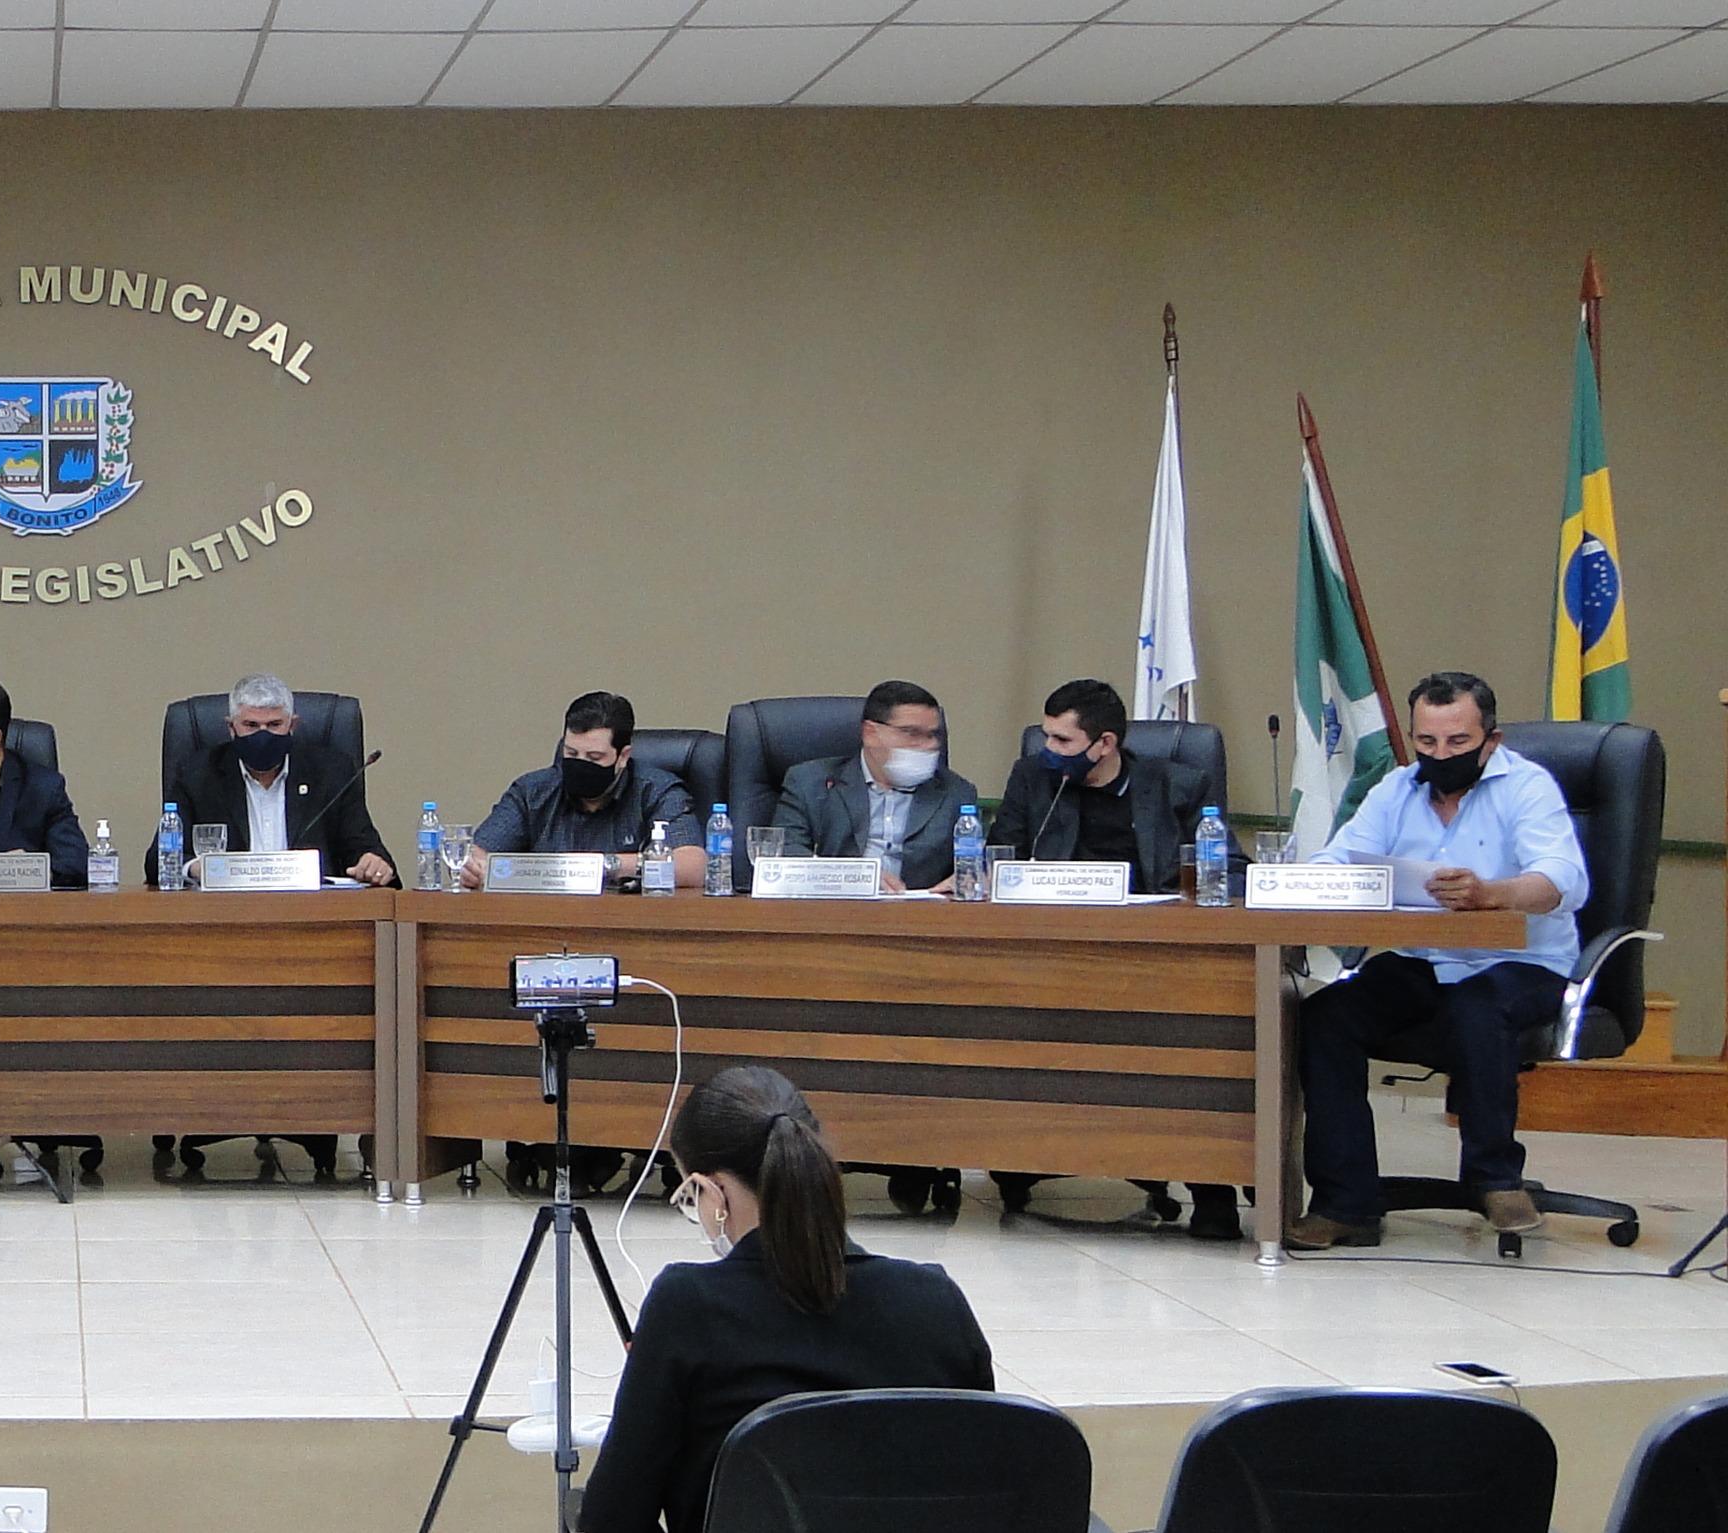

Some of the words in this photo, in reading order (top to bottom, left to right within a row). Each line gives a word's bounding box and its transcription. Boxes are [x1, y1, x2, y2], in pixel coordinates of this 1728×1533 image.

[19, 265, 313, 384] MUNICIPAL
[7, 507, 88, 527] BONITO
[1032, 877, 1055, 885] LUCAS
[1058, 877, 1093, 886] LEANDRO
[1095, 877, 1113, 886] PAES
